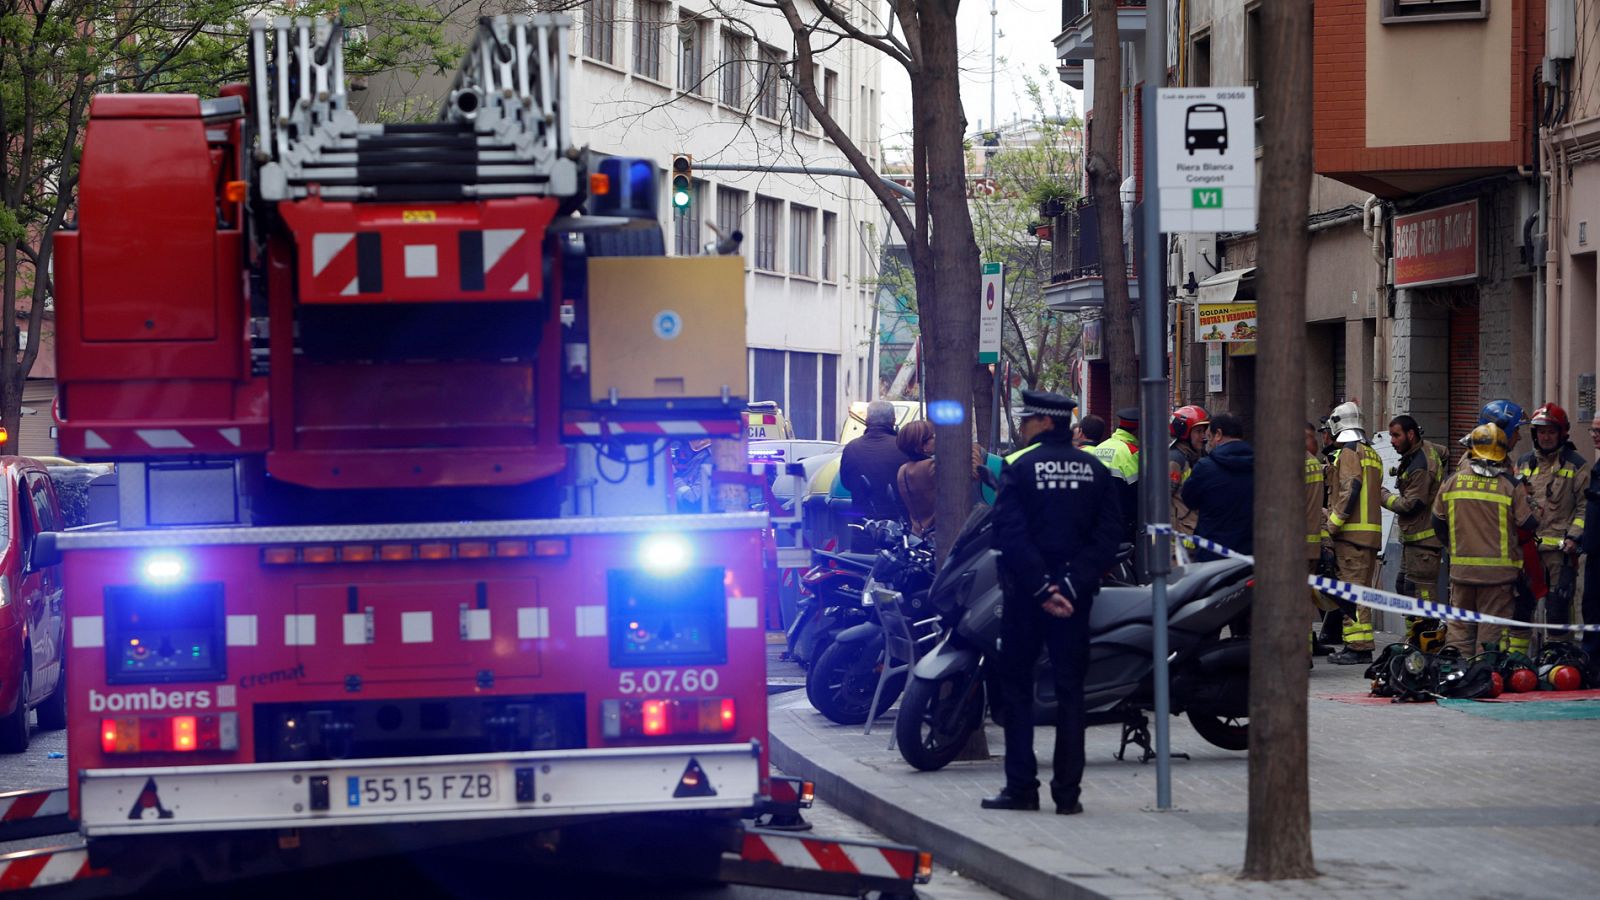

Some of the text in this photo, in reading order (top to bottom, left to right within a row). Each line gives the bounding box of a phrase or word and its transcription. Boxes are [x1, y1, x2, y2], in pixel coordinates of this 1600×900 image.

[1176, 163, 1234, 172] Riera Blanca
[1186, 174, 1225, 184] Congost
[1199, 191, 1218, 206] V1
[1199, 308, 1229, 317] GOLDAN
[1200, 316, 1221, 326] FRUTAS
[1226, 310, 1256, 322] VERDURAS
[747, 426, 767, 438] CIA
[1034, 461, 1094, 475] POLICIA
[239, 663, 306, 689] cremat
[619, 668, 720, 694] 5.07.60
[88, 687, 212, 712] bombers
[364, 776, 434, 803] 5515
[442, 774, 493, 799] FZB
